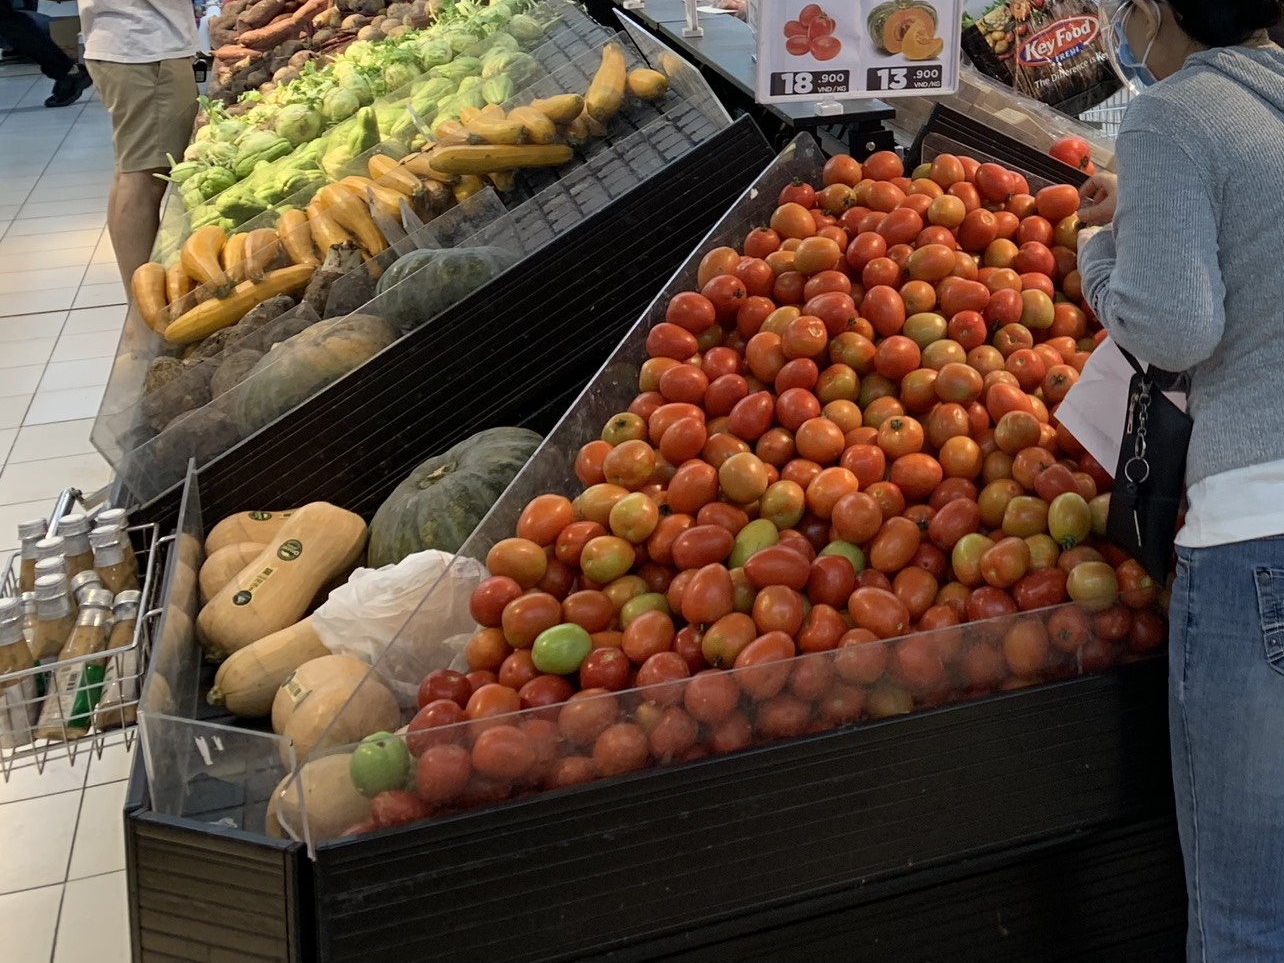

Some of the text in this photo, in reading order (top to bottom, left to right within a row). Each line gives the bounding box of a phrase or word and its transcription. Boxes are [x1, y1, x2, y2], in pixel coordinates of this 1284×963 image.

[1025, 19, 1091, 62] Key Food
[1055, 46, 1079, 63] FRESH
[781, 72, 813, 94] 18
[818, 74, 845, 83] .900
[877, 68, 908, 90] 13
[913, 70, 939, 79] .900
[1034, 77, 1050, 89] The
